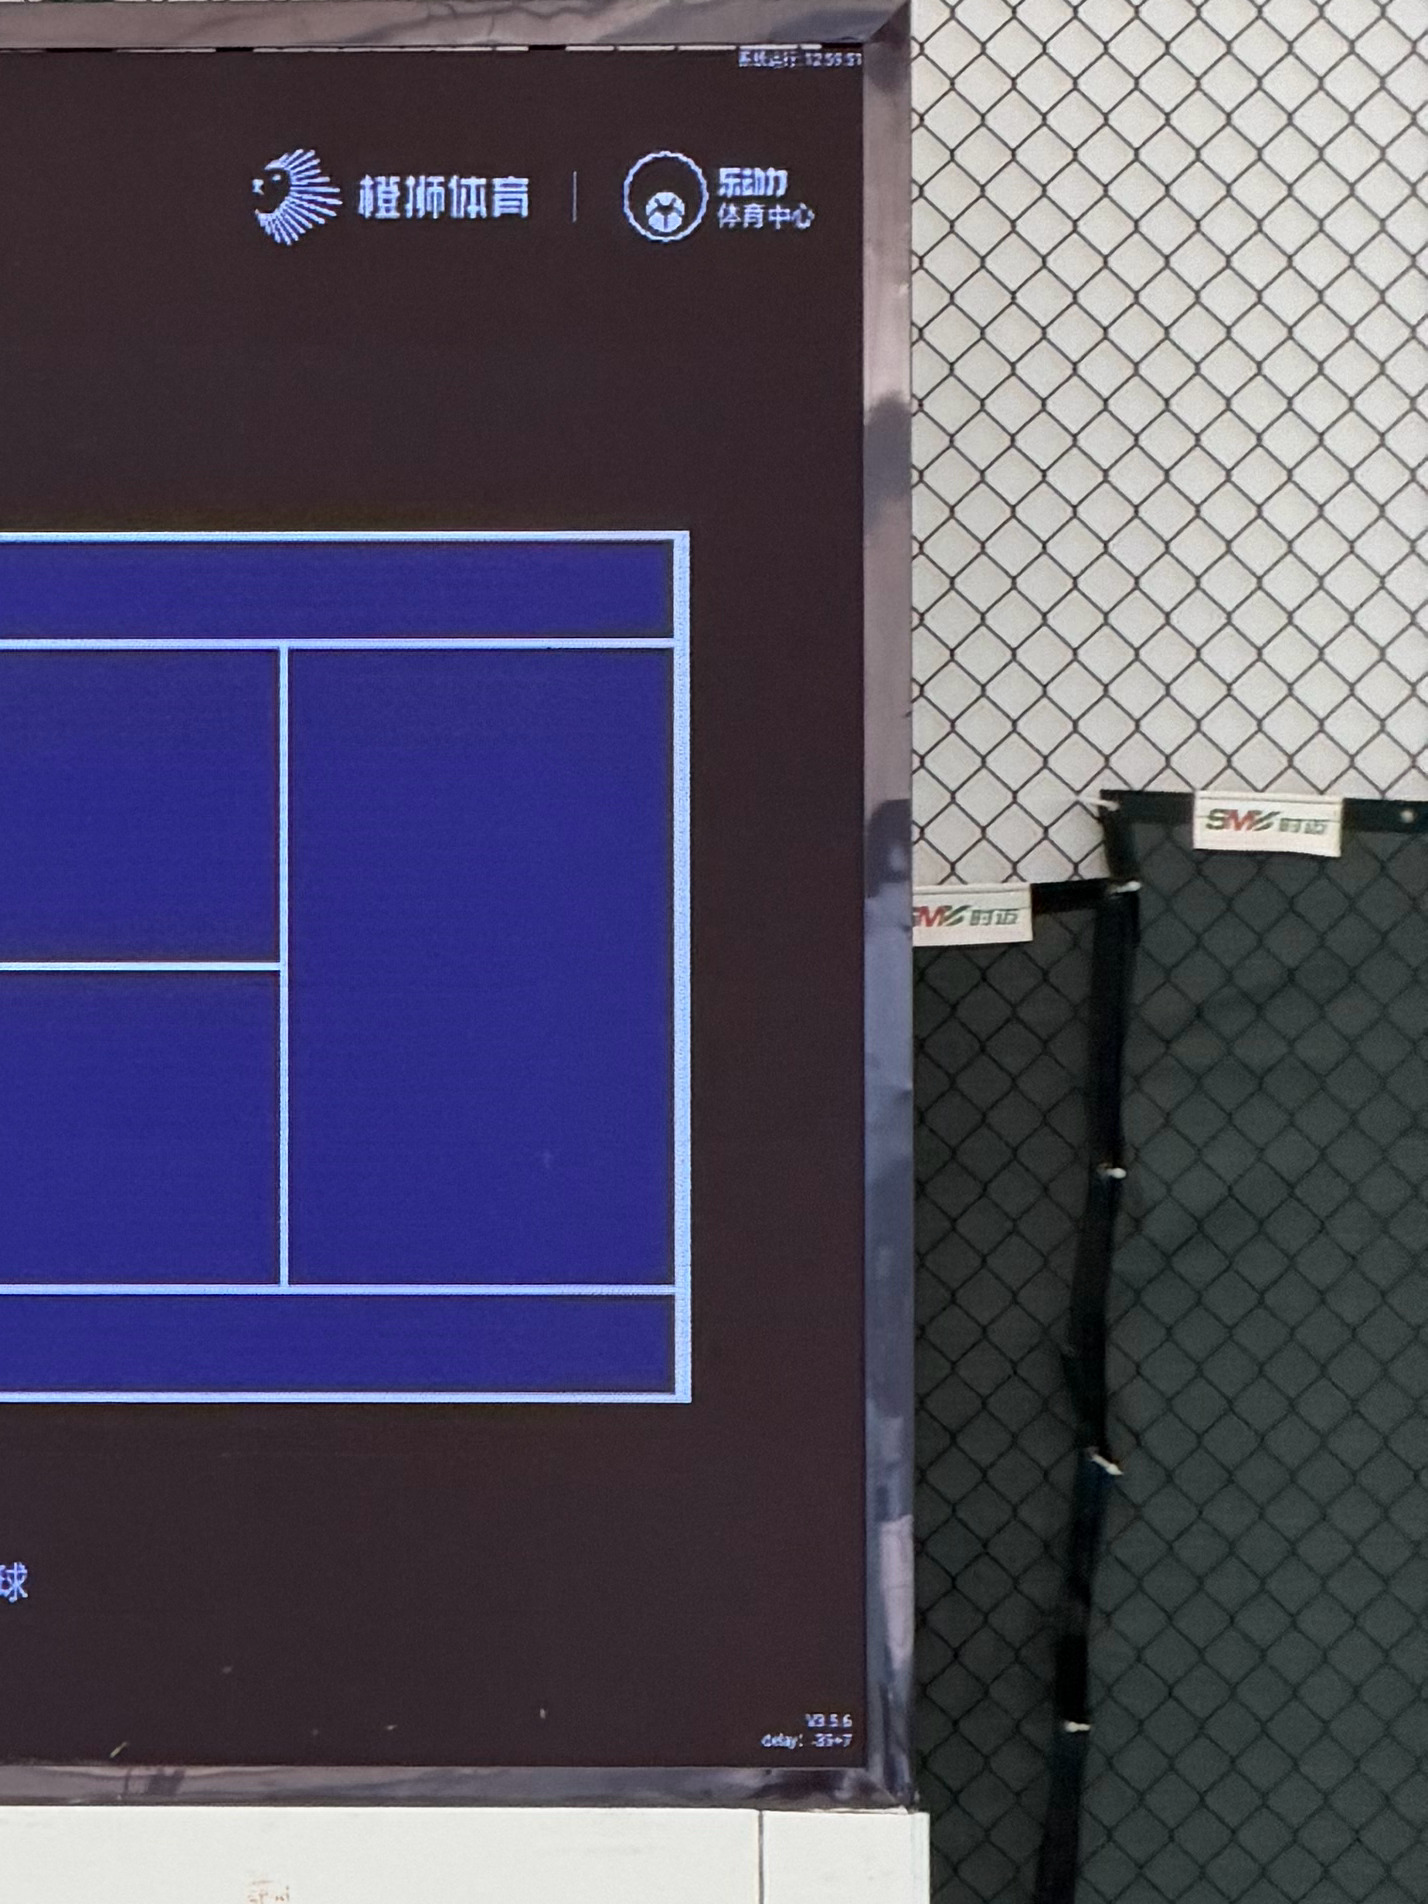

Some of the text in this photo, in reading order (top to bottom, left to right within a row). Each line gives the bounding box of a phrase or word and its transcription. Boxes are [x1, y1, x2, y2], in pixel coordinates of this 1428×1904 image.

[357, 174, 529, 220] 橙狮体育
[717, 202, 815, 230] 体育中心
